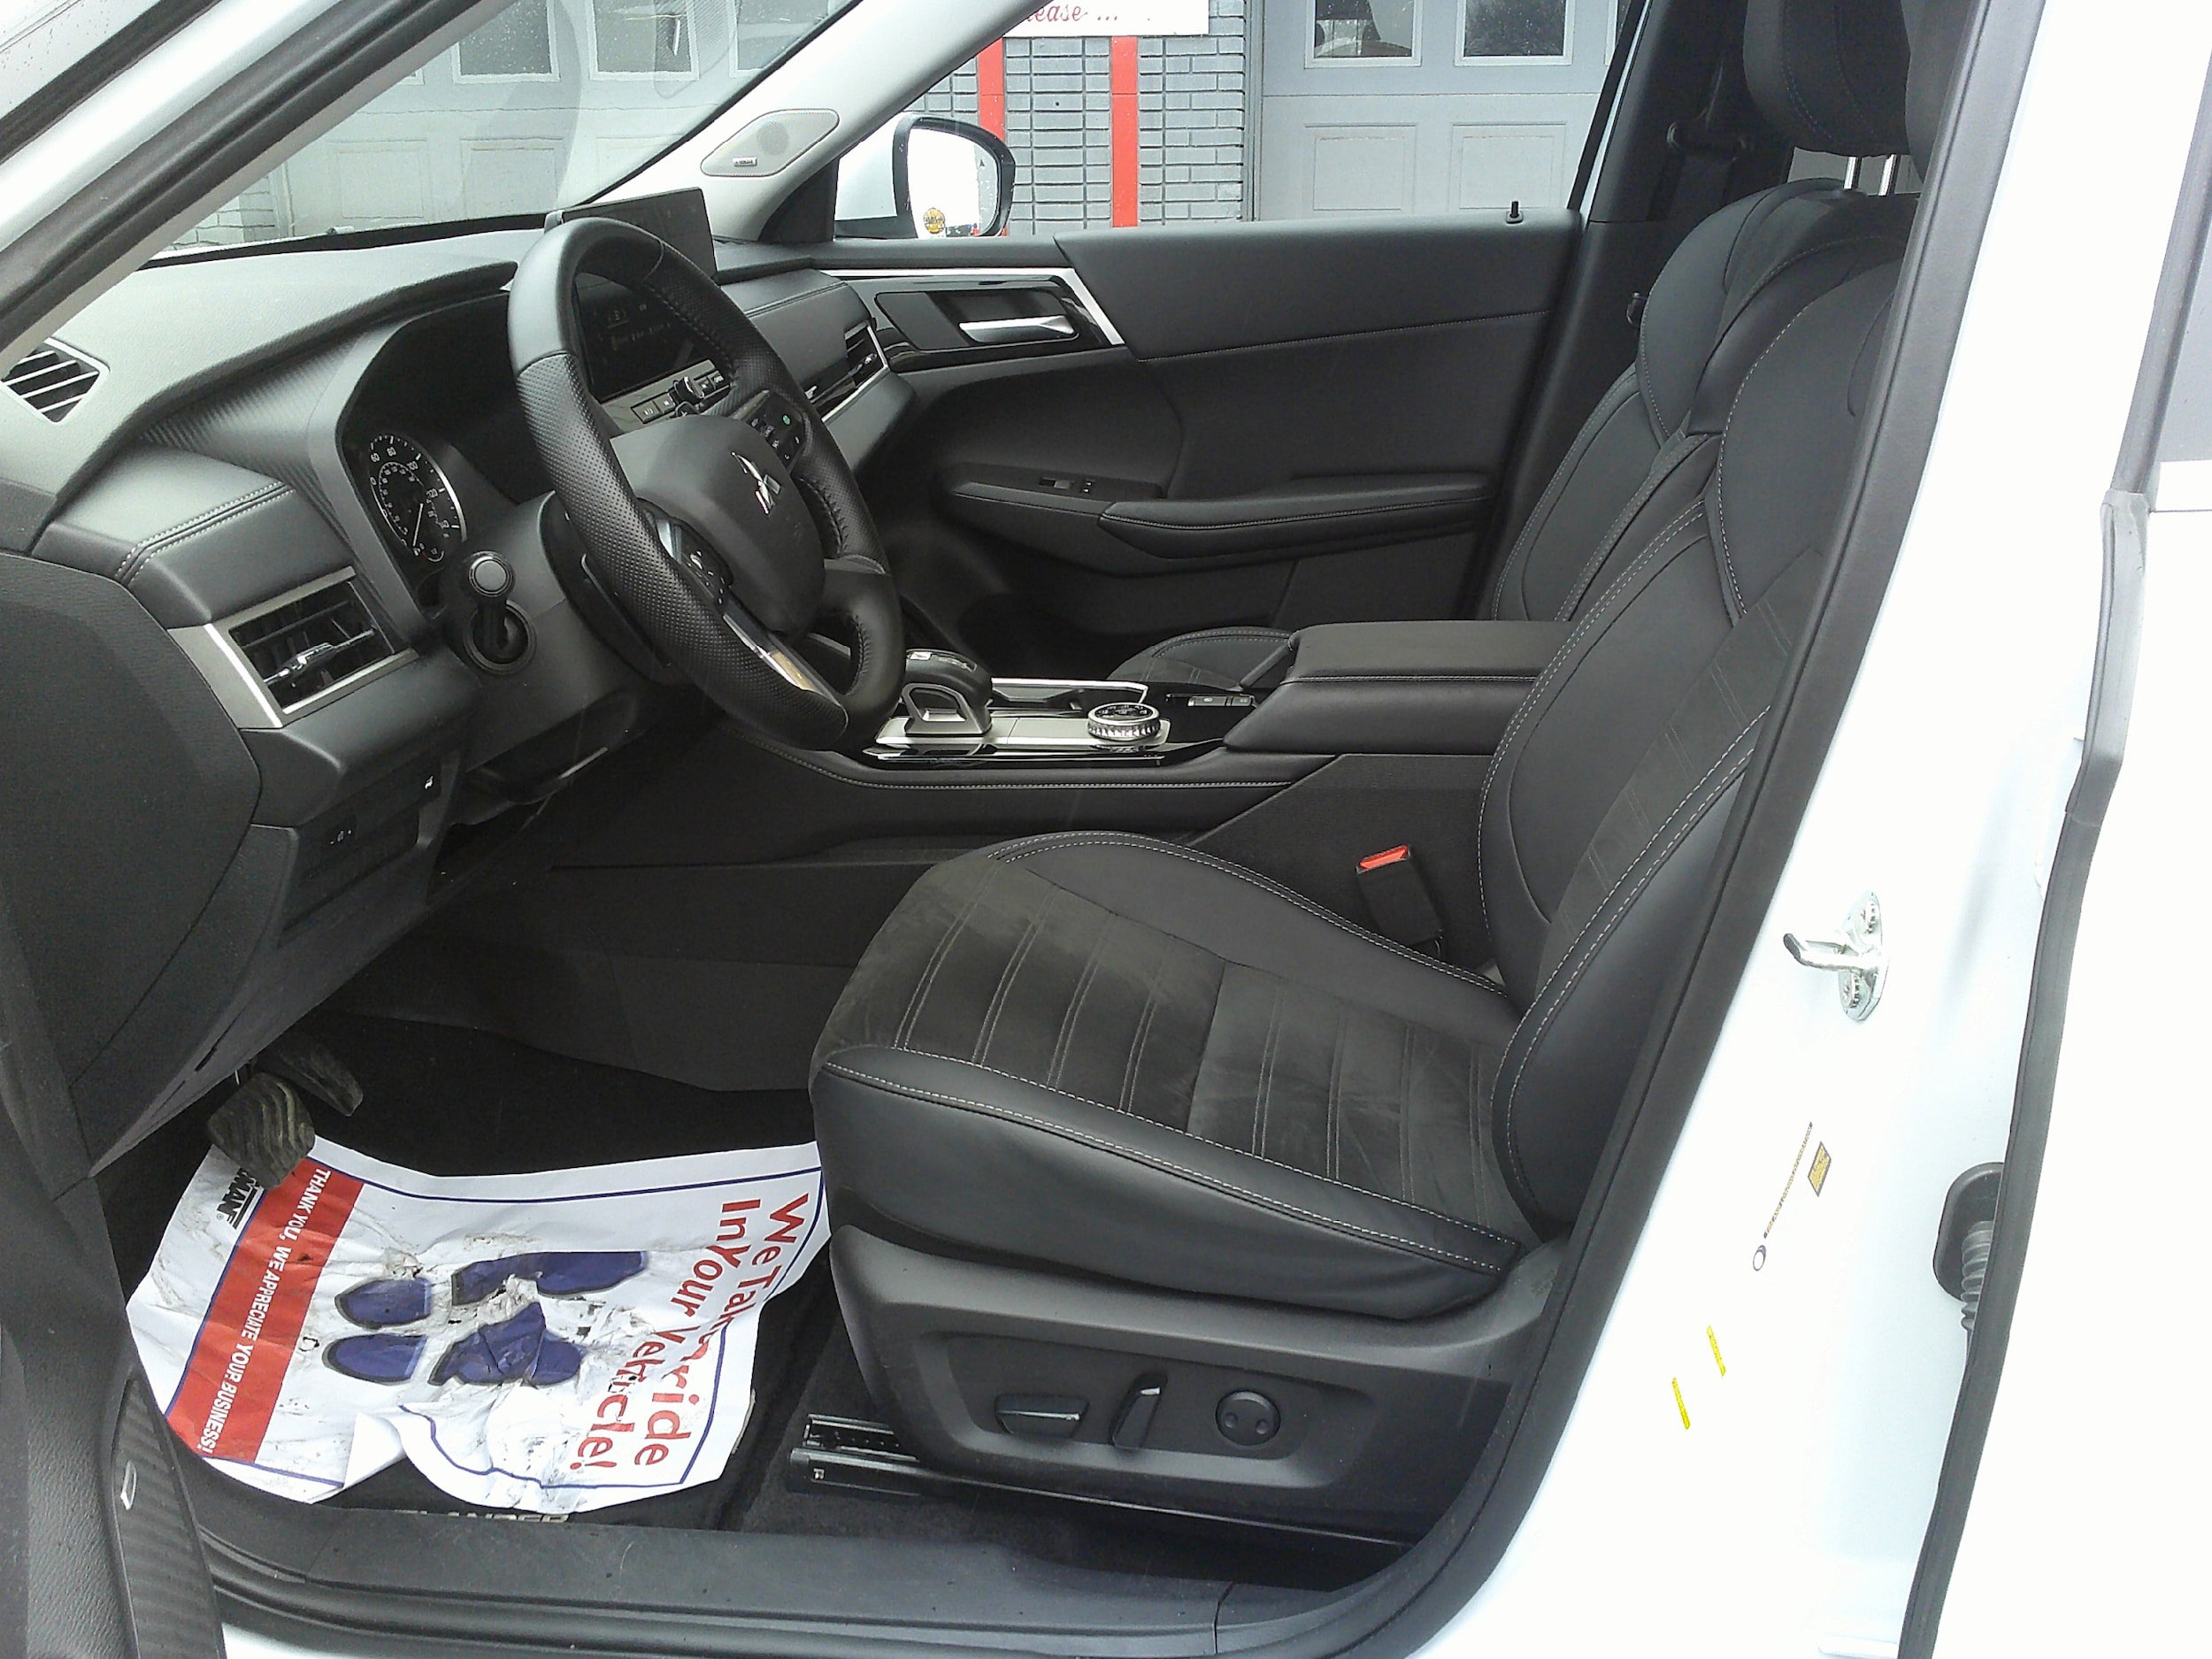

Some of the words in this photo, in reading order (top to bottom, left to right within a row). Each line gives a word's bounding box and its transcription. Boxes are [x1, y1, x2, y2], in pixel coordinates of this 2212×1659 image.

[296, 1168, 332, 1213] THANK
[279, 1212, 309, 1240] YOU,
[268, 1245, 293, 1271] WE
[241, 1271, 280, 1341] APPRECIATE
[224, 1342, 254, 1383] YOUR
[197, 1381, 237, 1454] BUSINESS!
[570, 1325, 701, 1470] Vehicle!
